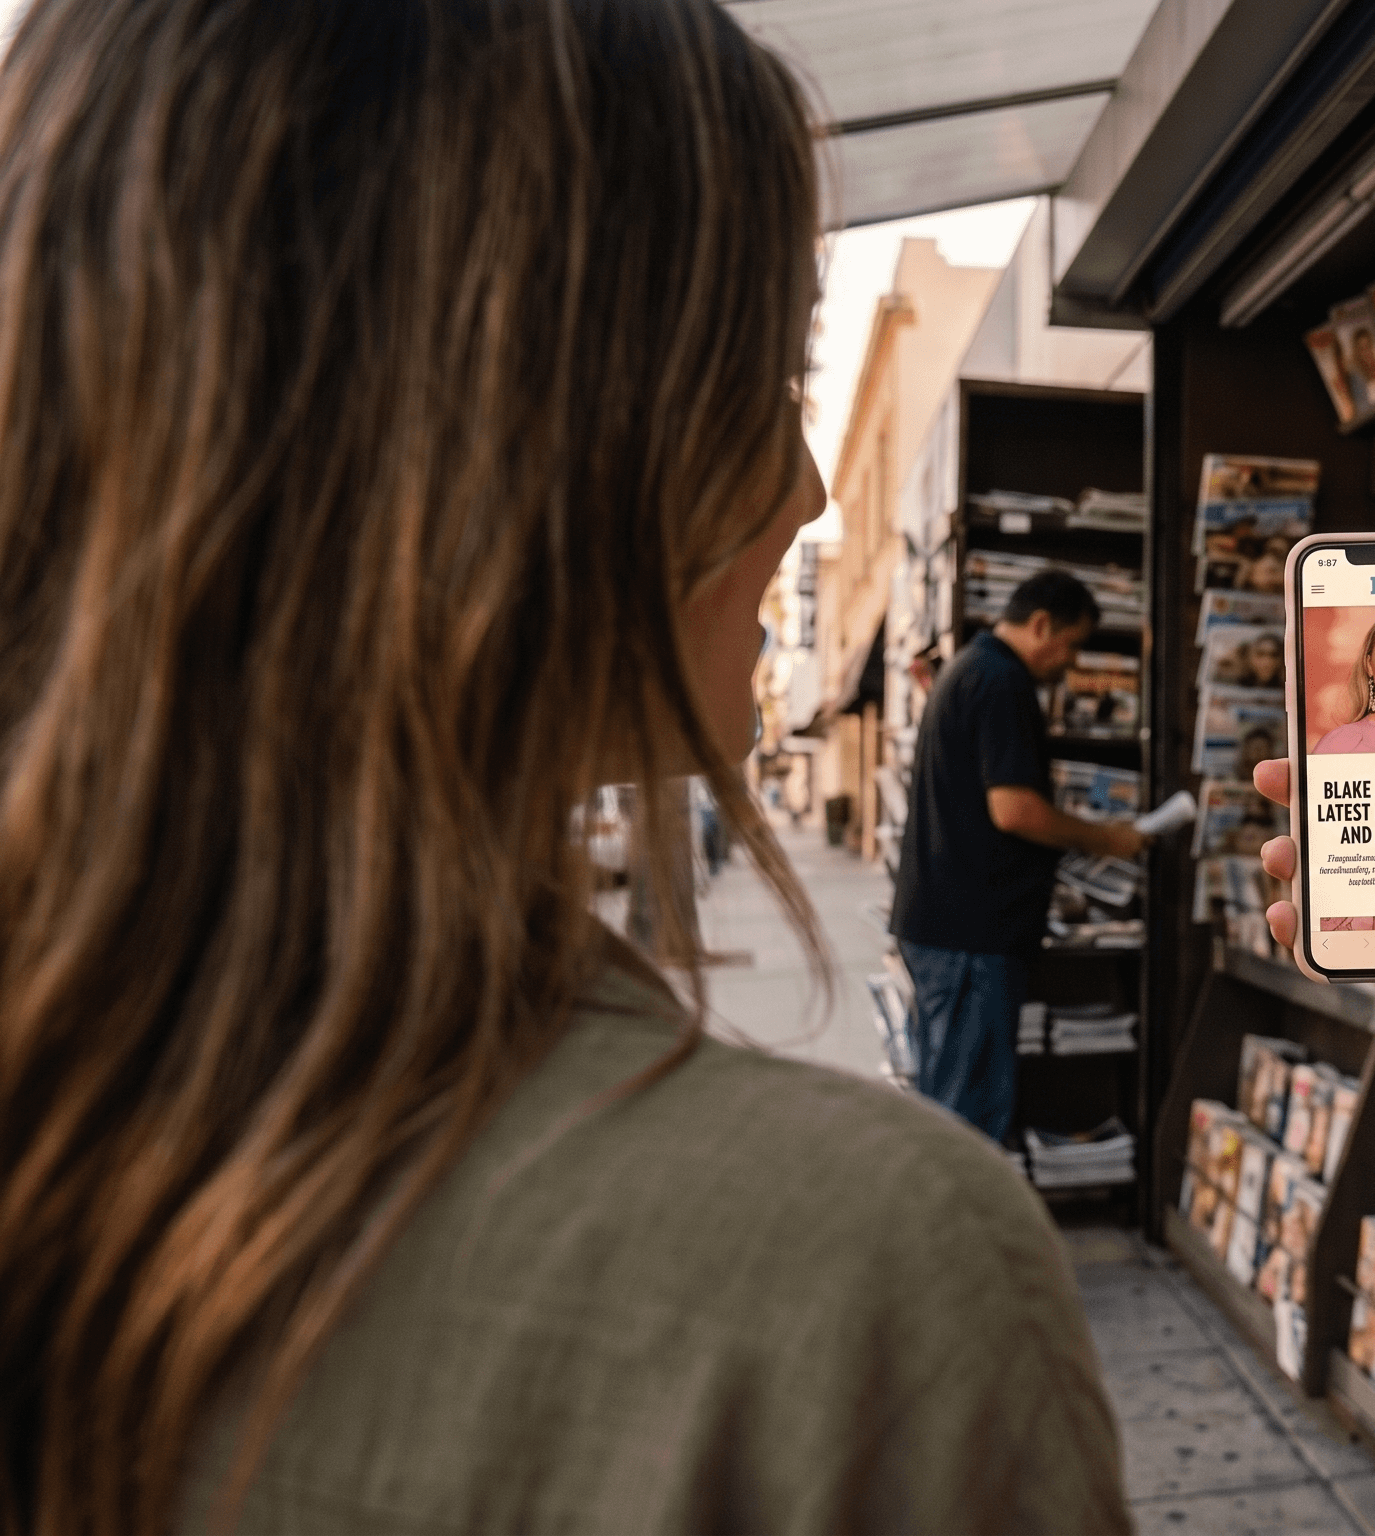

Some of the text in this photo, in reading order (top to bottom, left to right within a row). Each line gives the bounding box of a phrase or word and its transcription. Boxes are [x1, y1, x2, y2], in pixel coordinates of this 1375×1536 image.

[1317, 559, 1338, 567] 9:87
[1324, 780, 1371, 799] BLAKE
[1317, 803, 1371, 822] LATEST
[1340, 826, 1372, 845] AND
